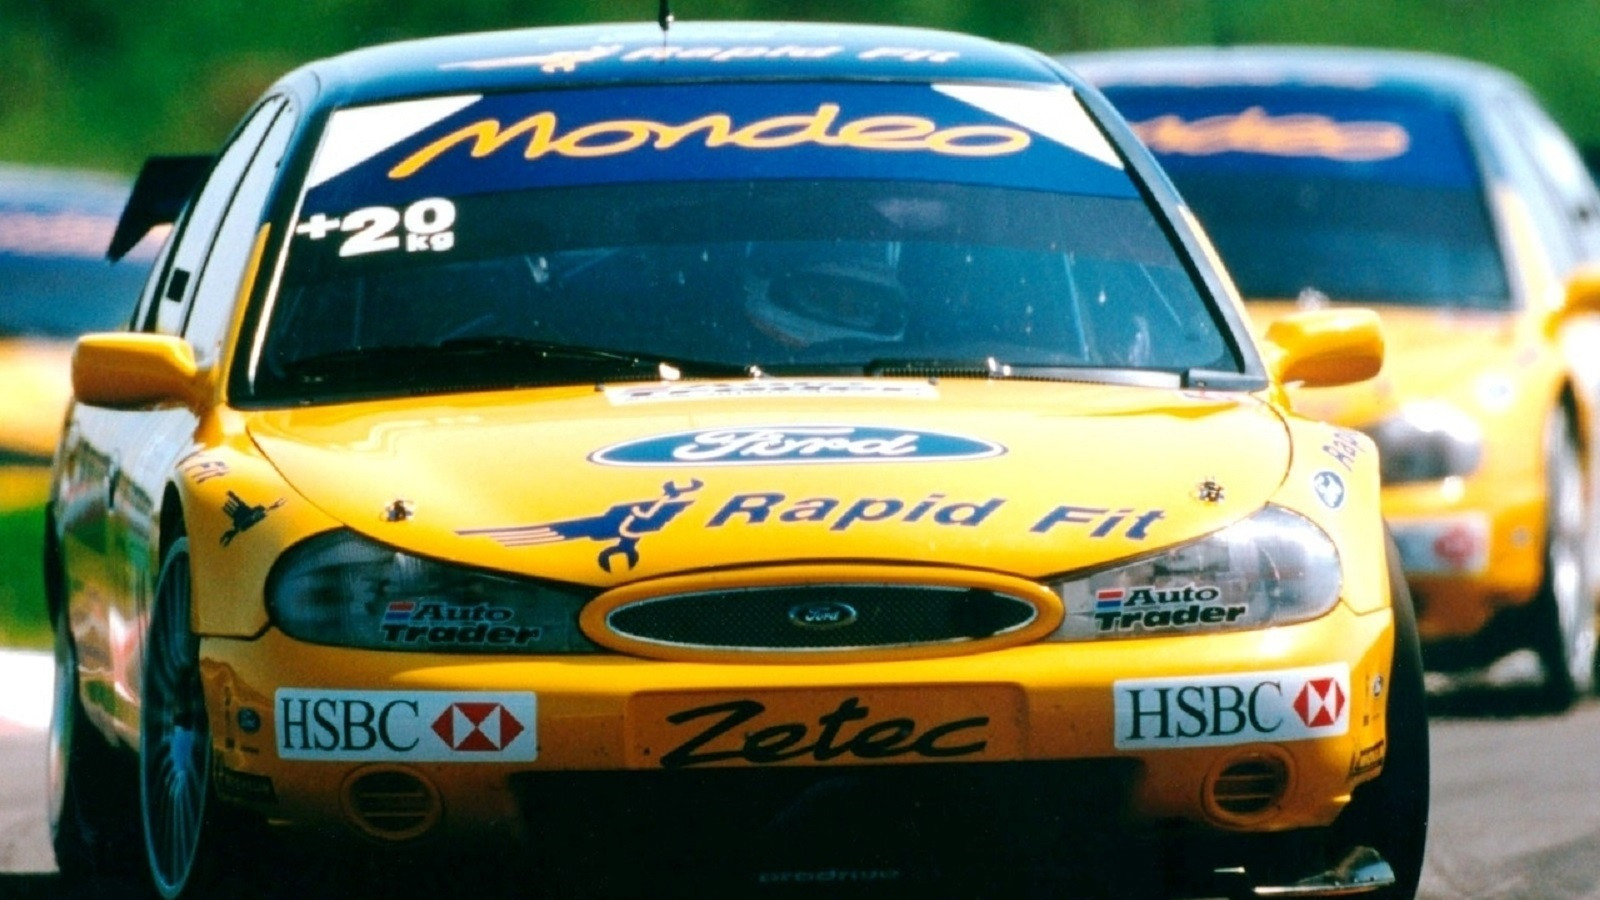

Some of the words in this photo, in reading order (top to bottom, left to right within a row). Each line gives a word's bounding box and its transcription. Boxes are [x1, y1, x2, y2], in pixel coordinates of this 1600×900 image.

[388, 103, 1031, 179] Mondeo
[405, 231, 455, 252] kg
[673, 427, 919, 461] Ford
[705, 491, 1006, 531] Rapid
[1029, 505, 1166, 540] Fit
[412, 601, 515, 622] Auto
[1123, 585, 1220, 607] Auto
[381, 613, 541, 645] Trader
[1094, 604, 1247, 632] Trader
[280, 696, 420, 753] HSBC
[1124, 680, 1283, 742] HSBC
[659, 697, 990, 769] Zetec
